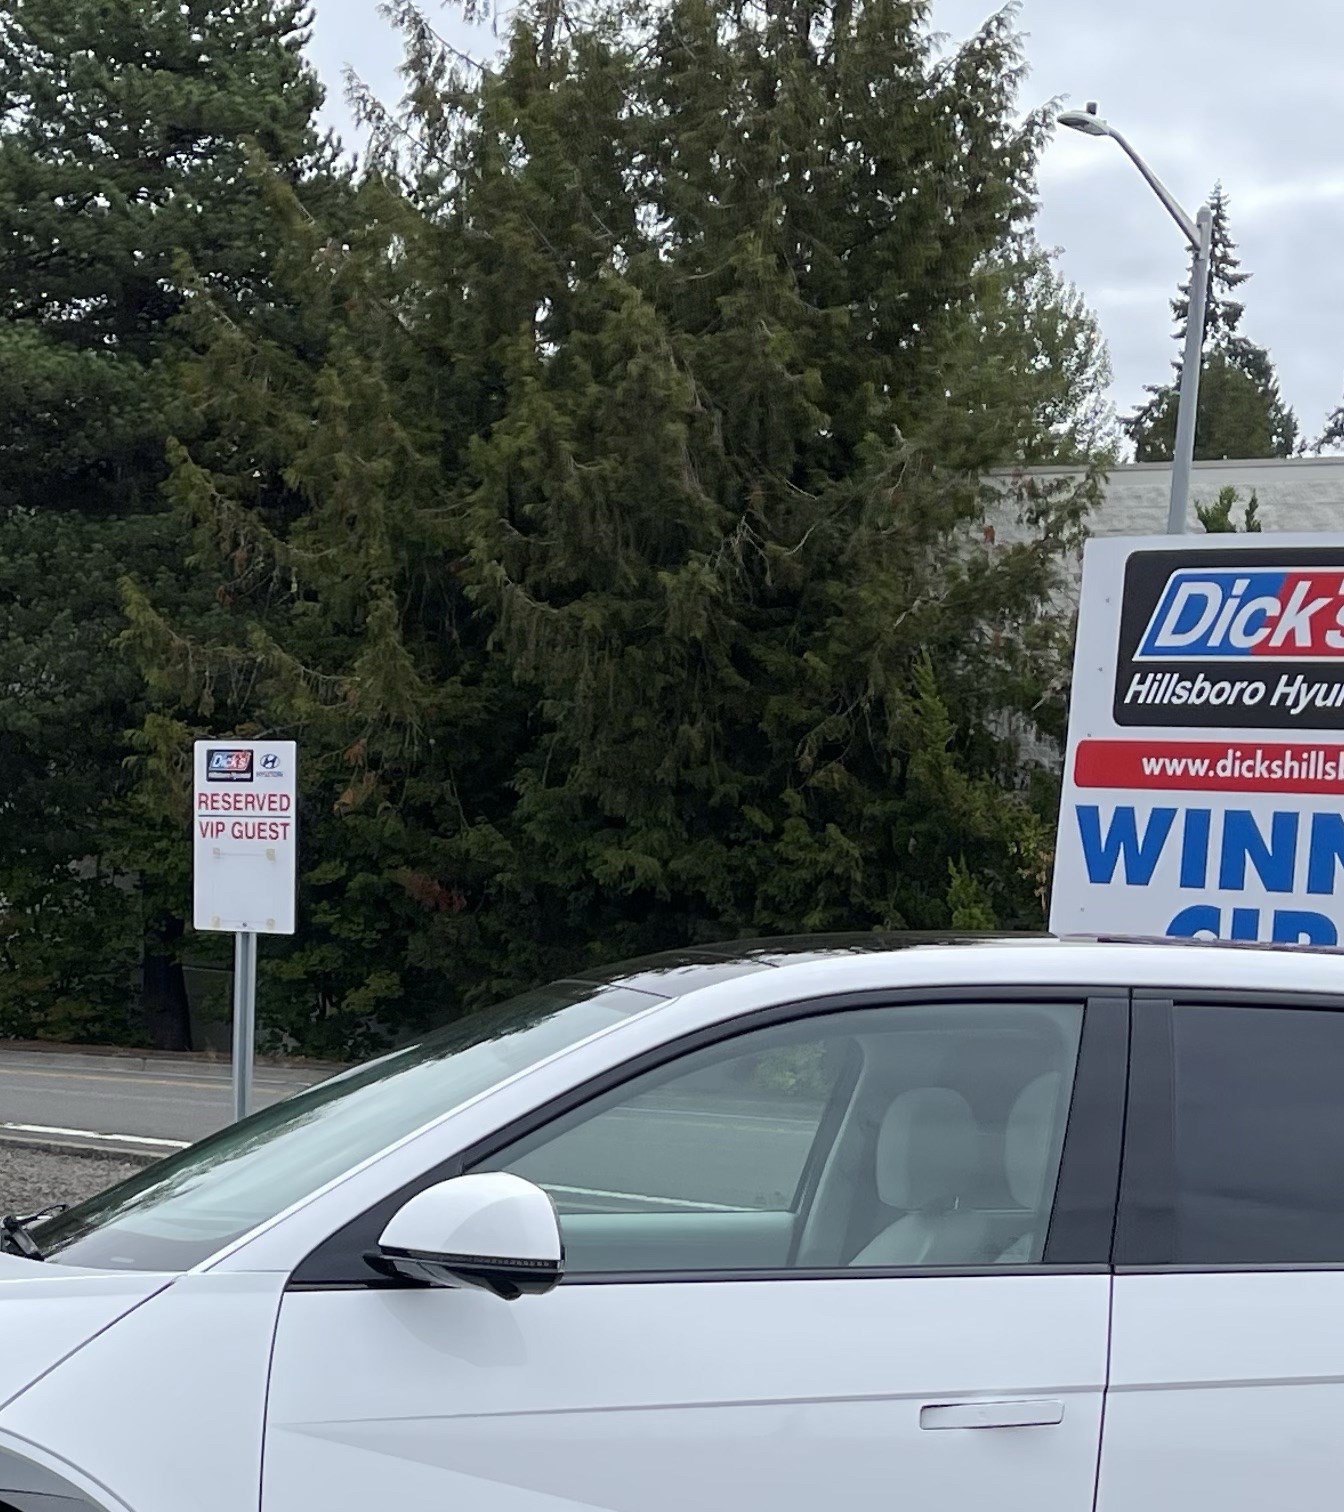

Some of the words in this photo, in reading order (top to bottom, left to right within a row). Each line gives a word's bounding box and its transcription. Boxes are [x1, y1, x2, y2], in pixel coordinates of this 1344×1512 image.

[1123, 673, 1266, 705] Hillsboro
[197, 793, 291, 812] RESERVED
[199, 821, 226, 838] VIP
[231, 822, 291, 840] GUEST
